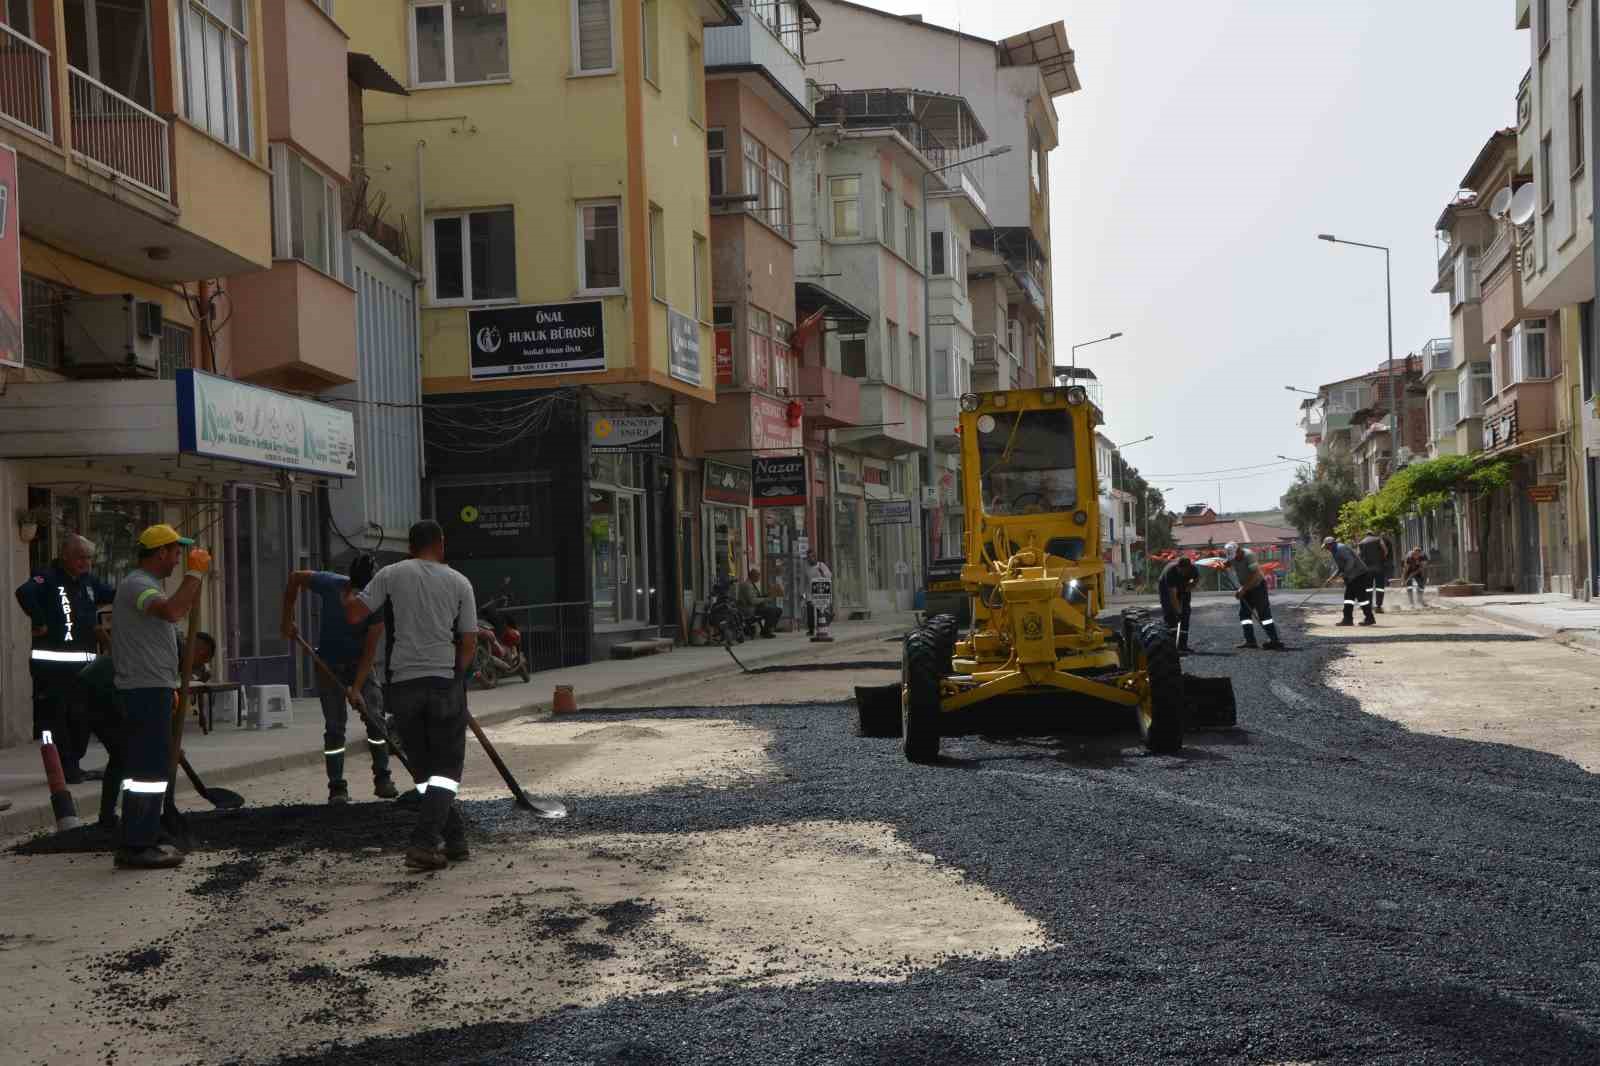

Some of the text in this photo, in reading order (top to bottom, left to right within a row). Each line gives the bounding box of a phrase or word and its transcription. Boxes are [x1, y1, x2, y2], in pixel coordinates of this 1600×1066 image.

[535, 310, 565, 323] ÖNAL
[508, 326, 595, 343] HUKUK BÜROSU
[755, 460, 802, 474] Nazar
[57, 586, 74, 641] ZABITA
